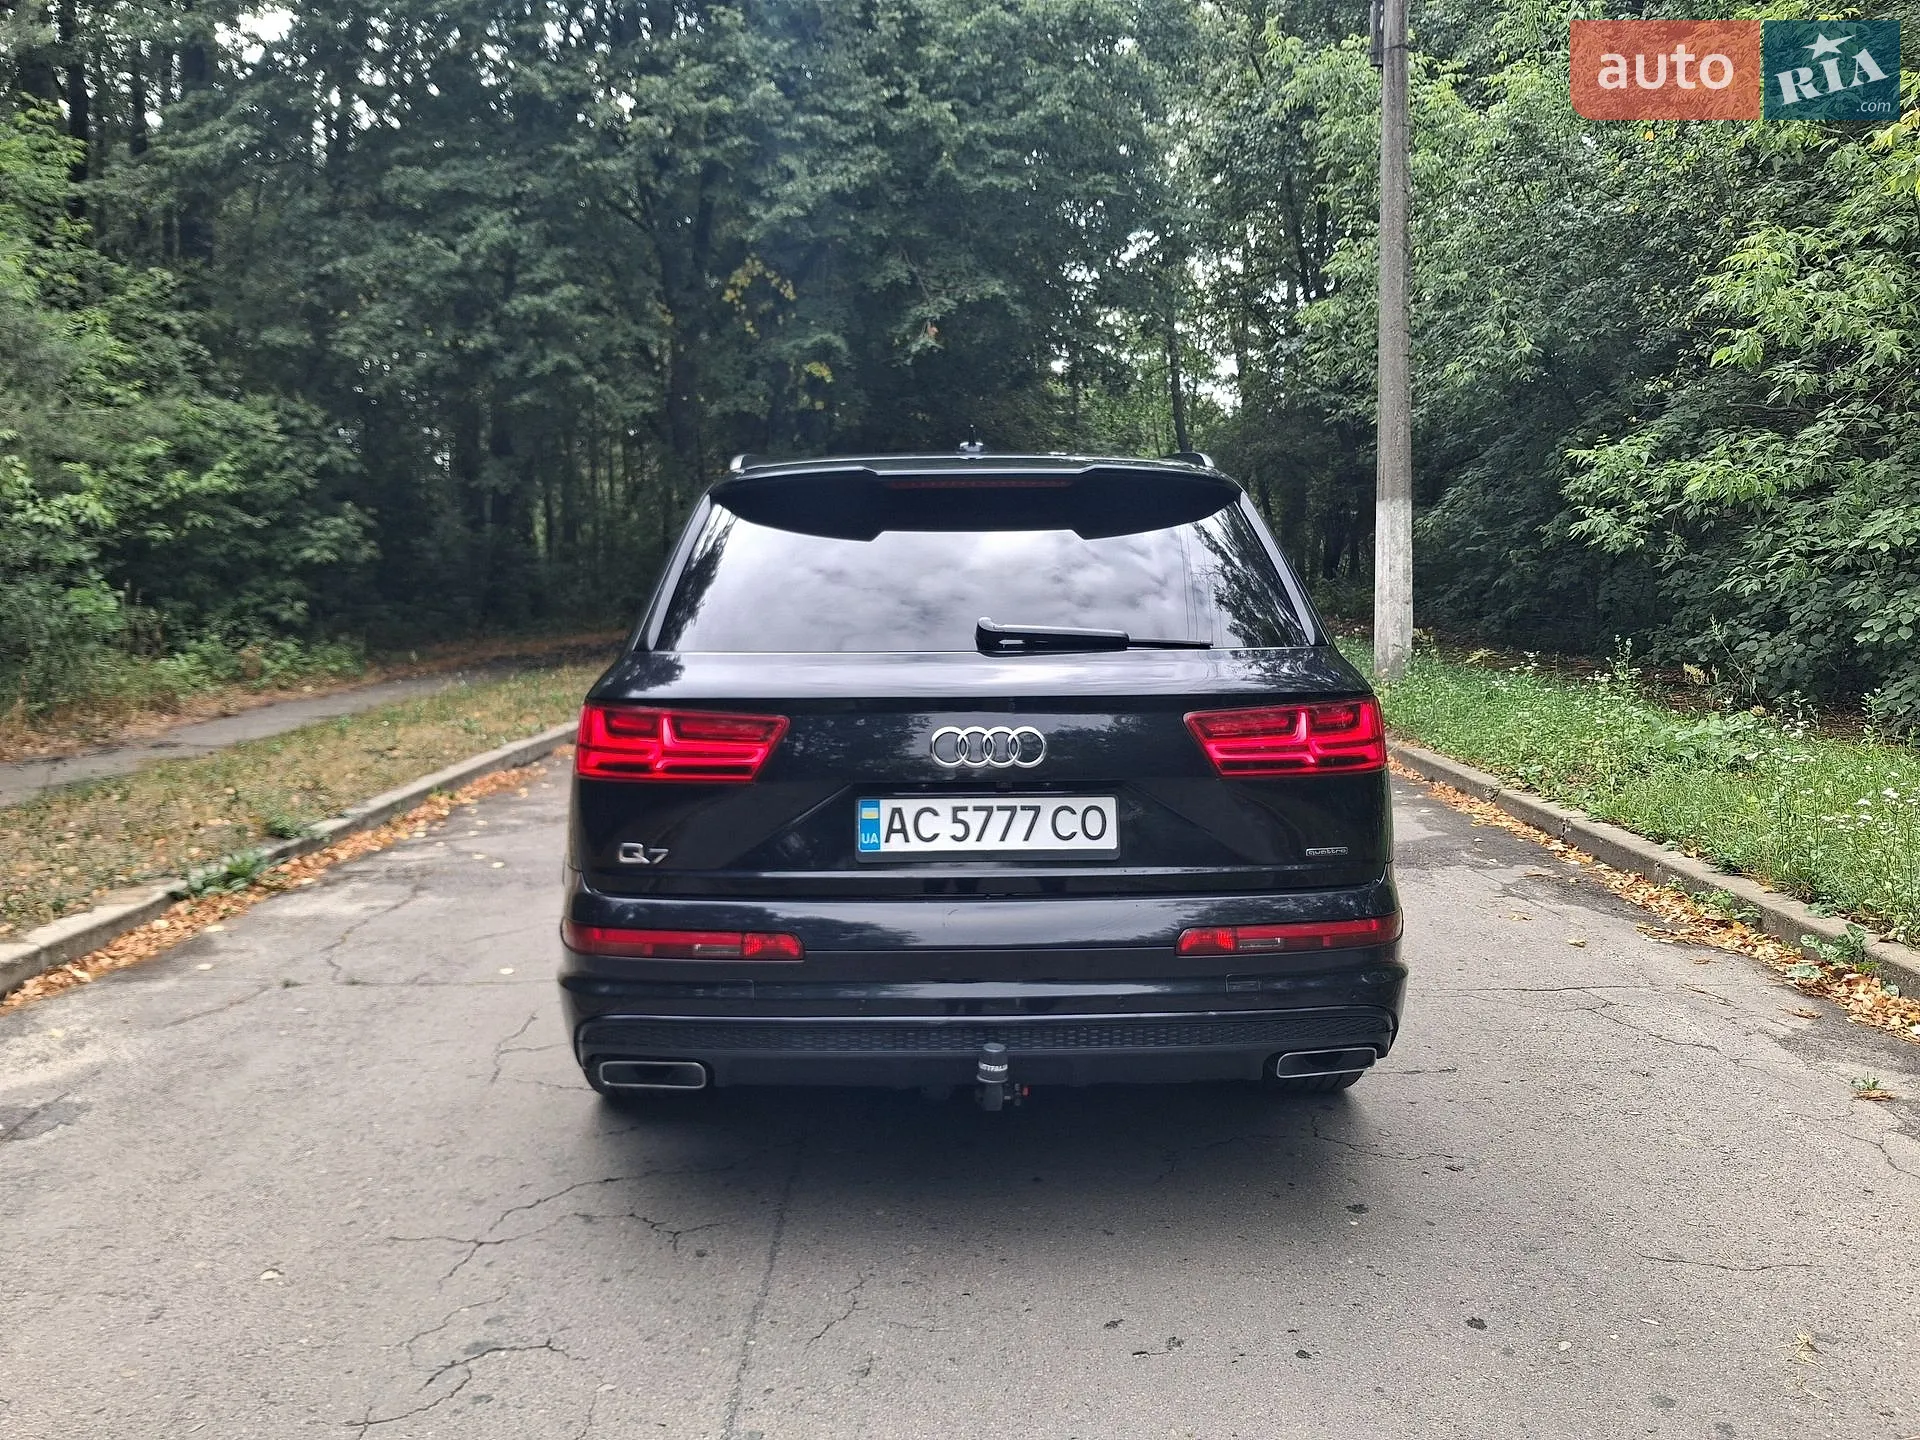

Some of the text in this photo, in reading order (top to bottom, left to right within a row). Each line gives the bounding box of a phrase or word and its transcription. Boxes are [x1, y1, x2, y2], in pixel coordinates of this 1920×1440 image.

[884, 805, 1107, 843] AC 5777 CO
[862, 832, 879, 844] UA
[619, 842, 669, 864] Q7
[1308, 848, 1346, 856] quattro
